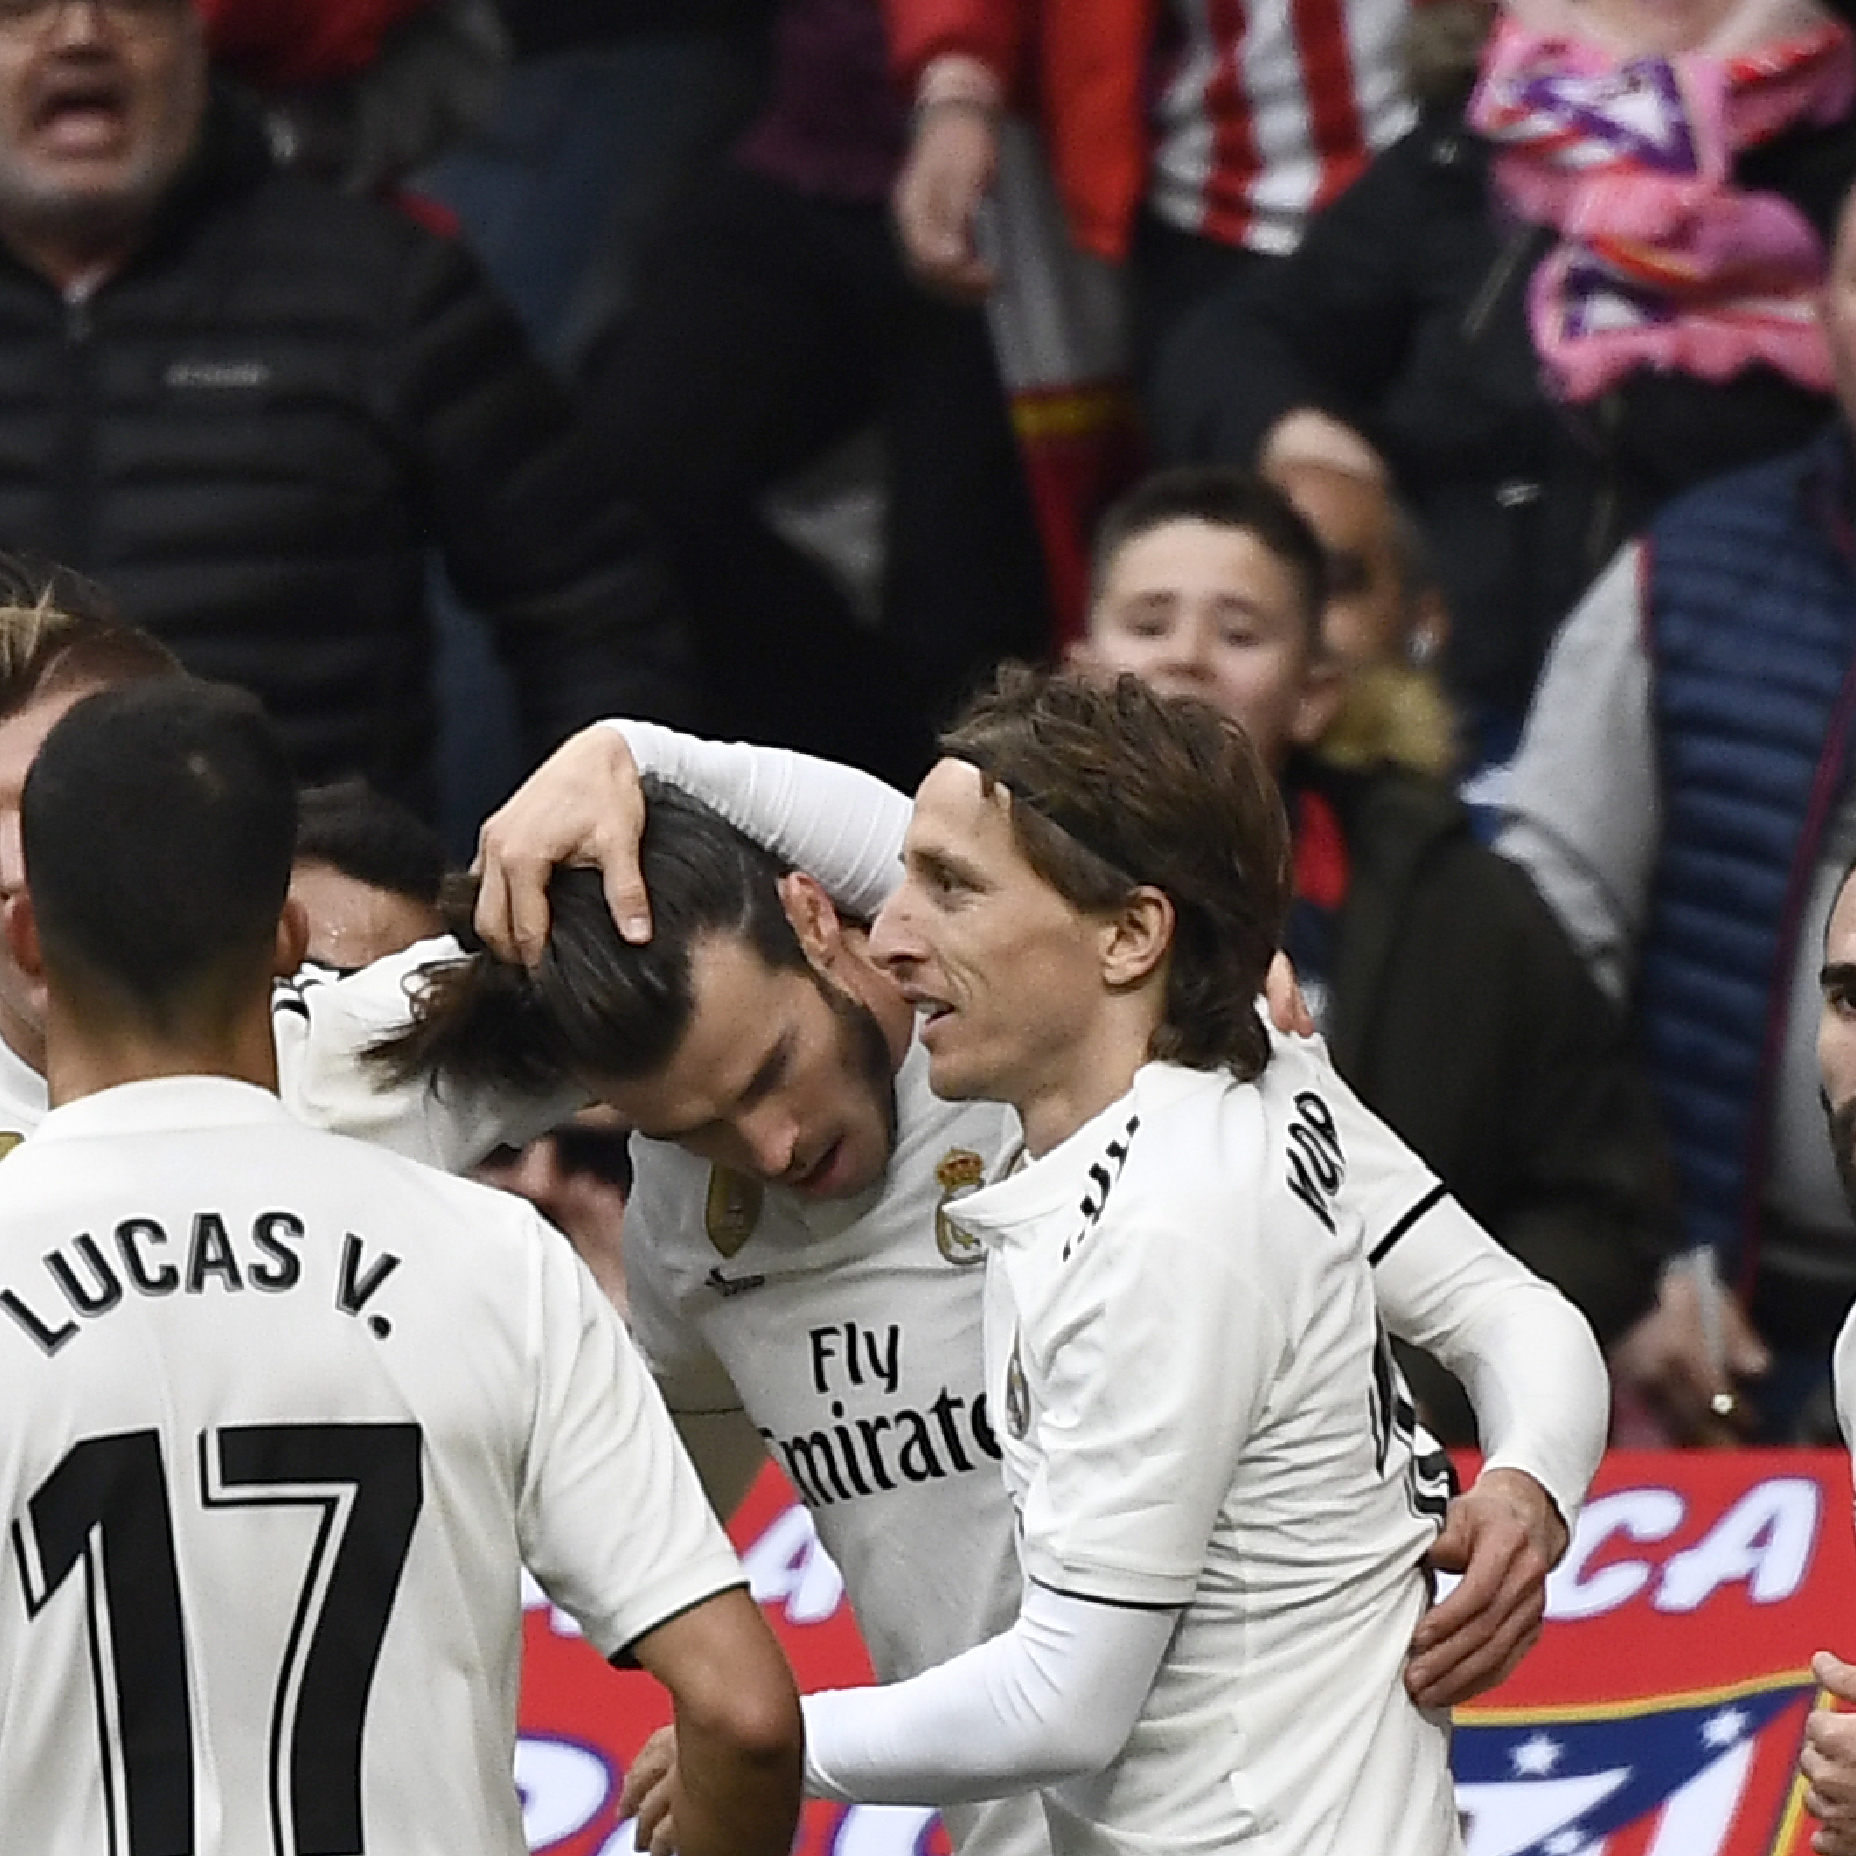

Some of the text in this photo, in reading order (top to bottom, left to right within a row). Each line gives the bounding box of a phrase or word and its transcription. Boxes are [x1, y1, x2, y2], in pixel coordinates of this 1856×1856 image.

[335, 1231, 402, 1341] V.
[808, 1320, 900, 1395] Fly
[758, 1386, 1004, 1508] mirat
